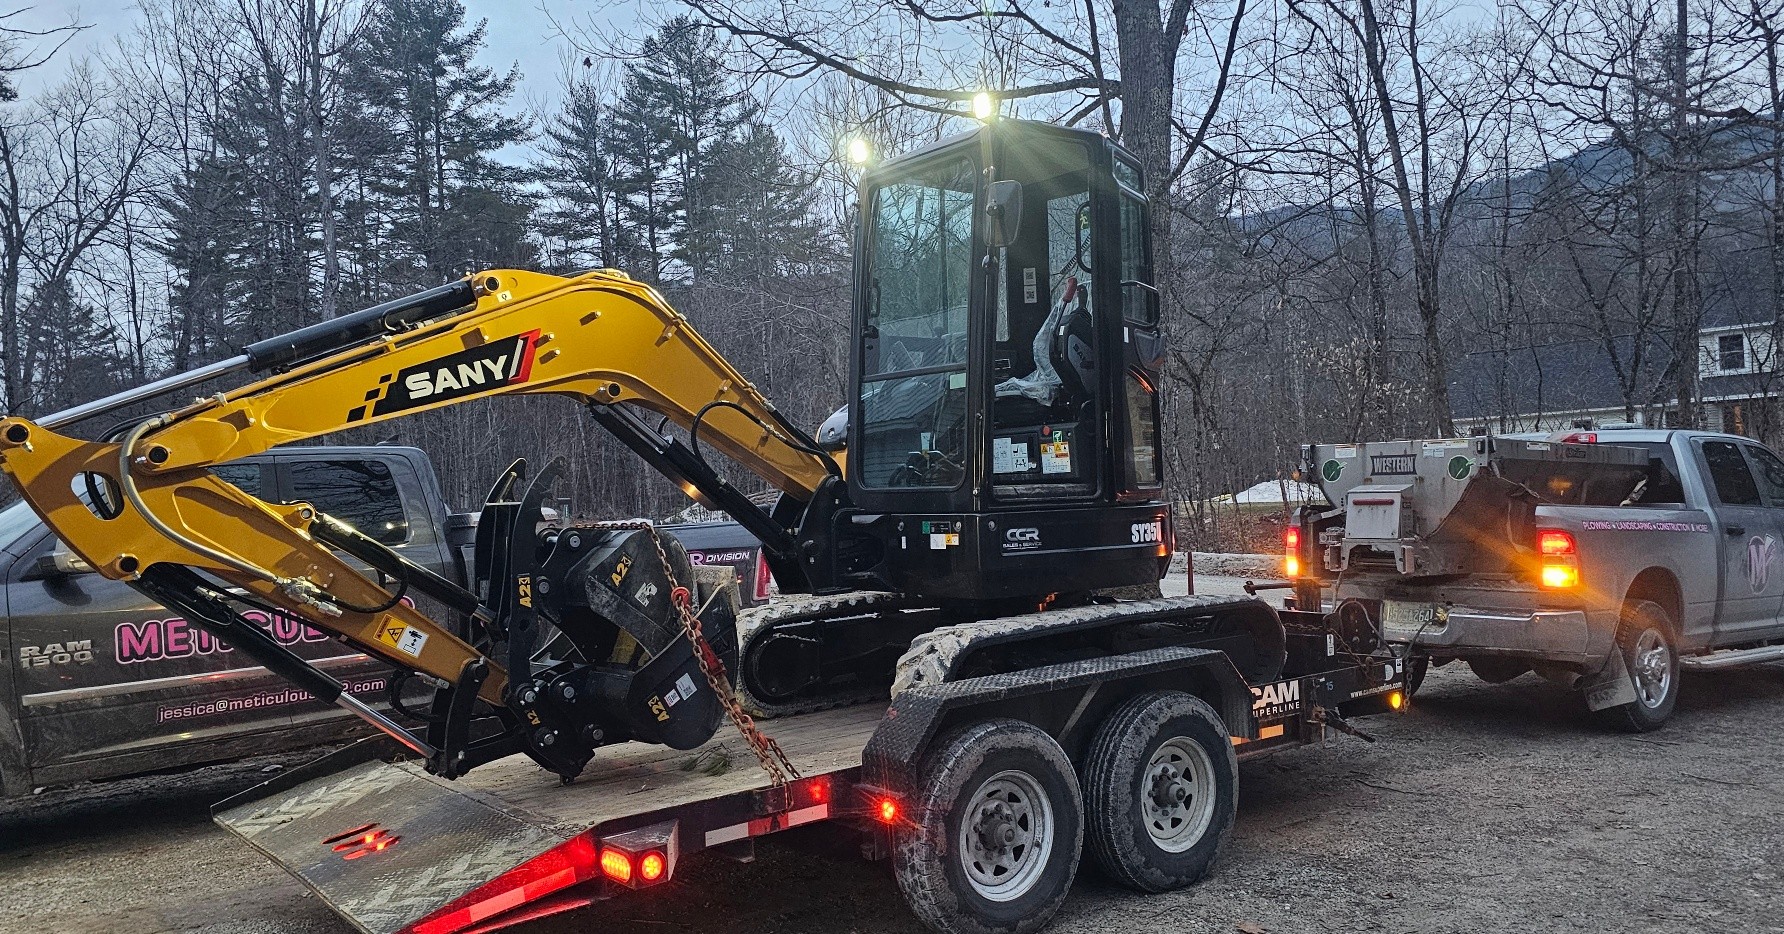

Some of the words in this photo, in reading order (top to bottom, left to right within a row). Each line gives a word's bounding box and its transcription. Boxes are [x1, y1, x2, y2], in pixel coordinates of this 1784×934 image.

[405, 355, 508, 400] SANY
[1374, 456, 1414, 473] WESTERN
[1007, 528, 1040, 541] CCR
[1583, 521, 1611, 531] PLOWING
[1616, 521, 1653, 531] LANDSCAPING
[1656, 522, 1690, 531] CONSTRUCTION
[706, 551, 750, 563] DIVISION
[20, 640, 91, 657] RAM
[21, 650, 92, 669] 1500
[1350, 681, 1402, 698] www.camsuperline.com
[1253, 702, 1299, 717] UPERLINE
